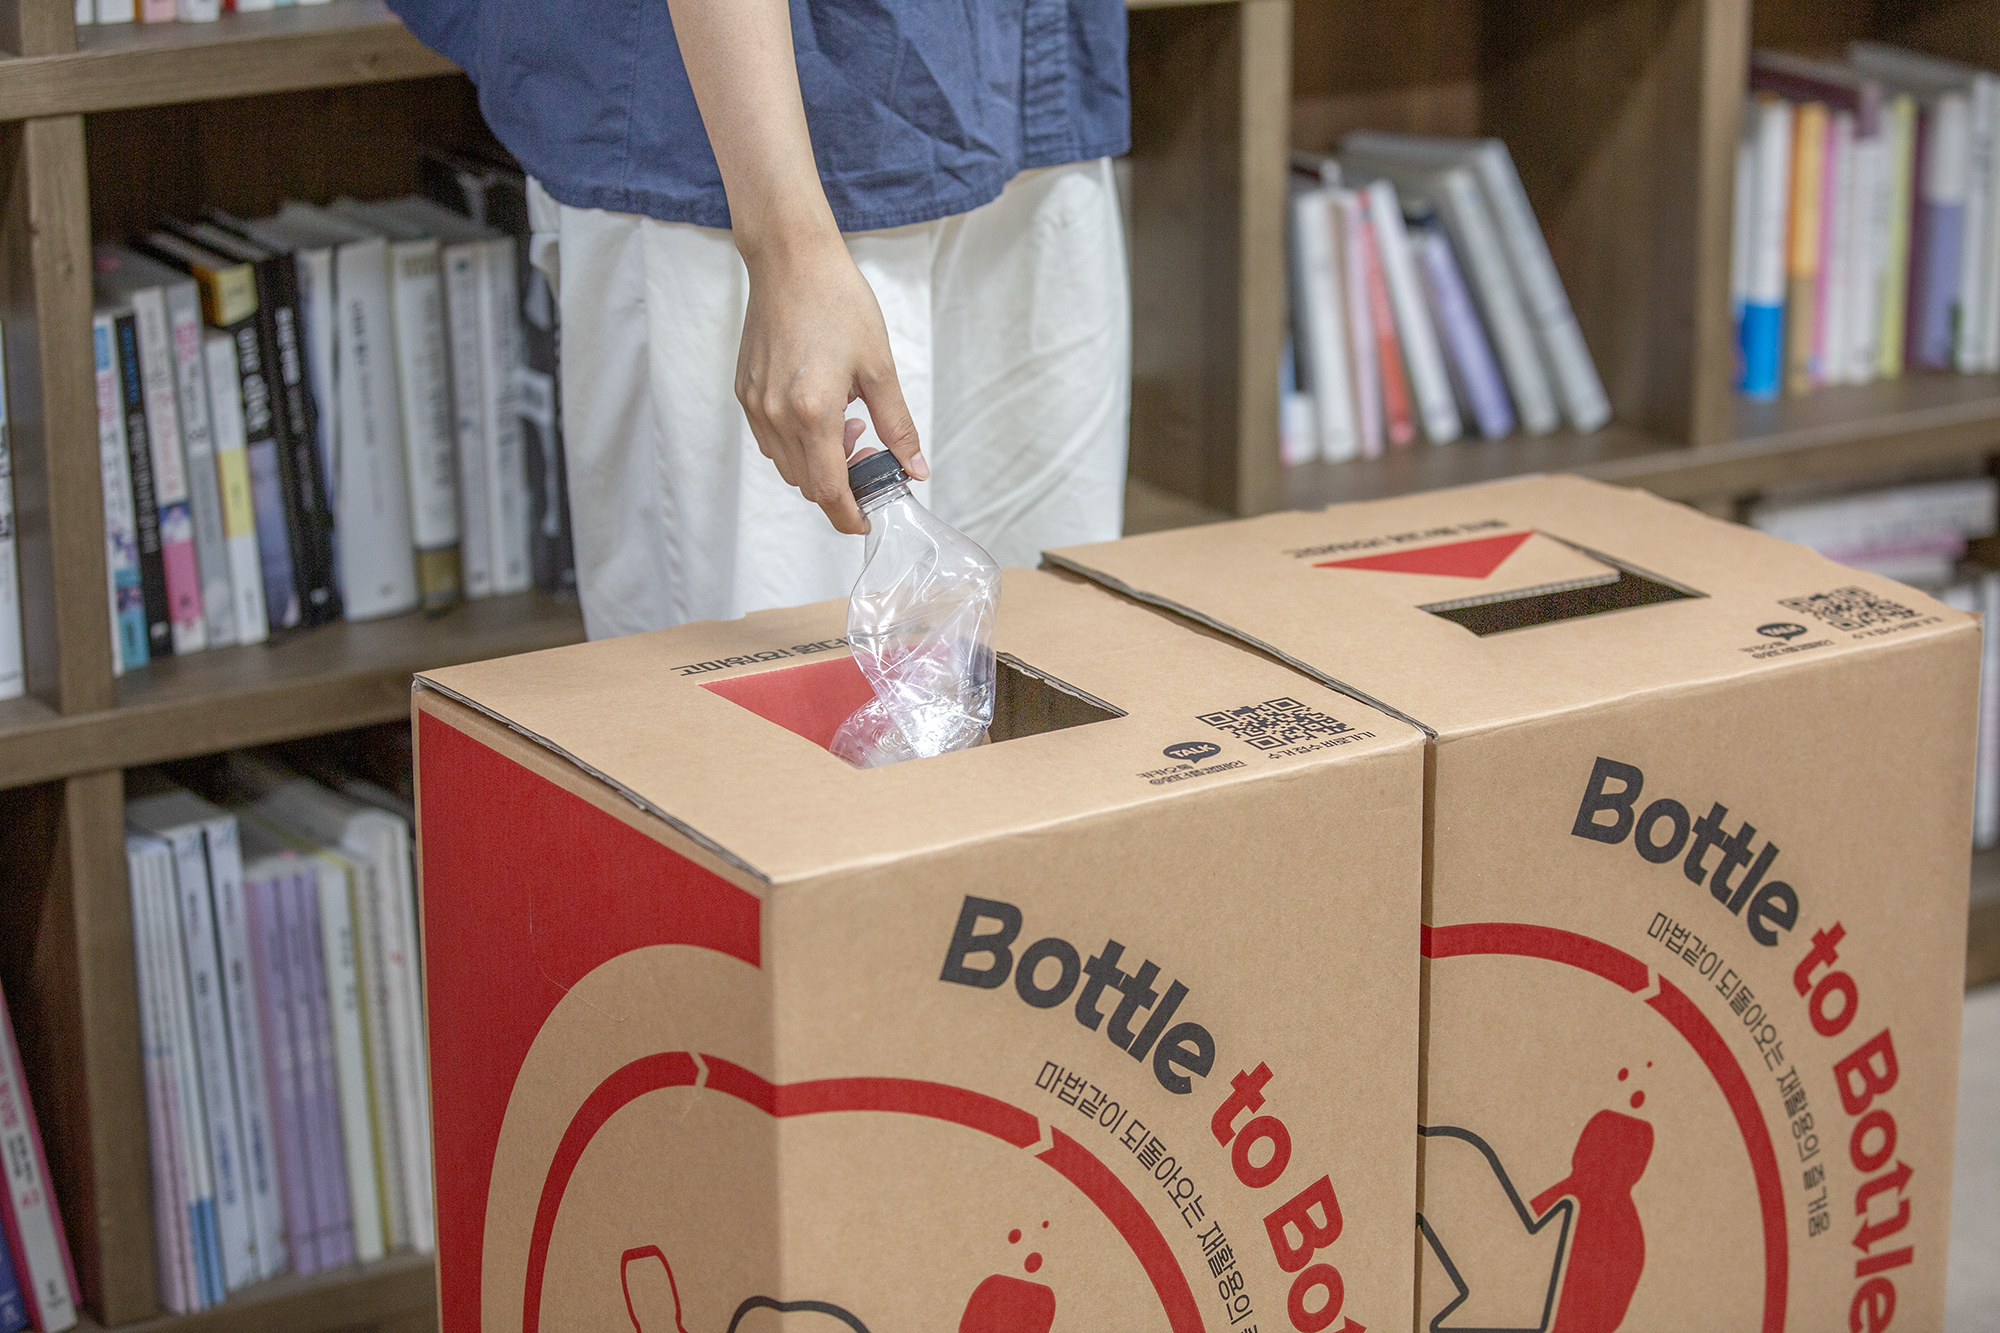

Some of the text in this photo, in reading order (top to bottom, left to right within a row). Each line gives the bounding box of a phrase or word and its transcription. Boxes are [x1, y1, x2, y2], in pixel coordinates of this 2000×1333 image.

[670, 636, 850, 677] 고마워요! 원더
[1168, 744, 1216, 758] TALK
[940, 896, 1367, 1333] Bottle to Bo
[1571, 757, 1913, 1333] Bottle to Bottle
[1647, 912, 1830, 1238] 마법같이 되돌아오는 재활용의 즐거움
[1034, 1061, 1254, 1326] 마법같이 되돌아오는 재활용의
